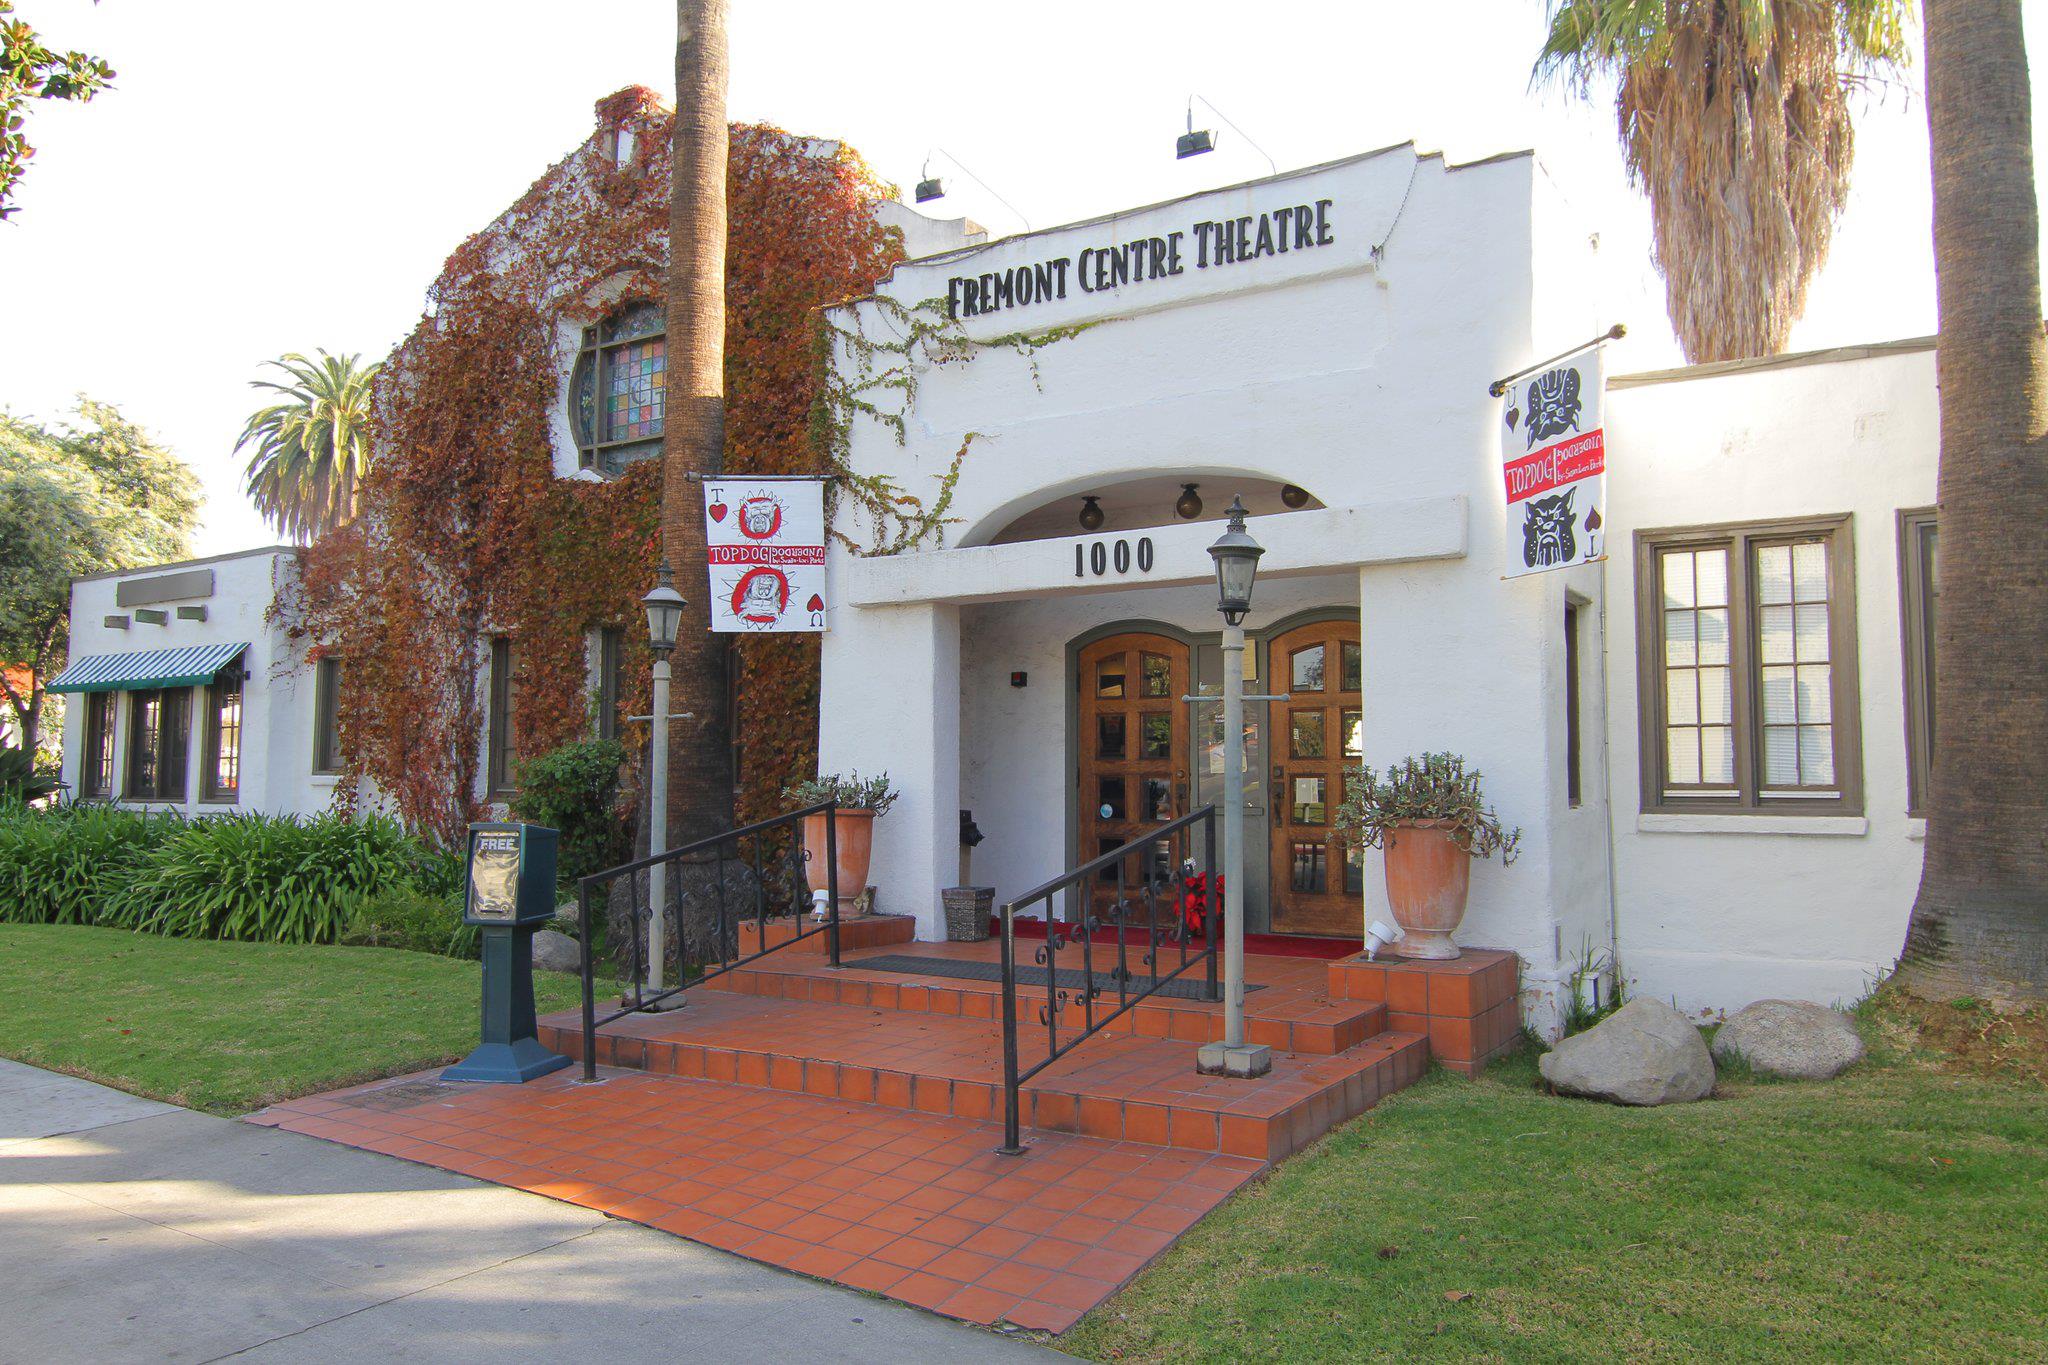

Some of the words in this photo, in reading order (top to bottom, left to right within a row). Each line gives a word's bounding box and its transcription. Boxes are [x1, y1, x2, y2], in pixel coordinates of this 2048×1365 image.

[948, 257, 1071, 320] FREMONT
[1078, 231, 1184, 293] CENTRE
[1193, 199, 1335, 269] THEATRE
[1506, 453, 1553, 495] TOPDOG
[711, 488, 724, 503] T
[711, 547, 768, 563] TOPDOG
[772, 547, 823, 557] UNDERDOG
[1075, 537, 1153, 577] 1000
[480, 838, 515, 850] FREE
